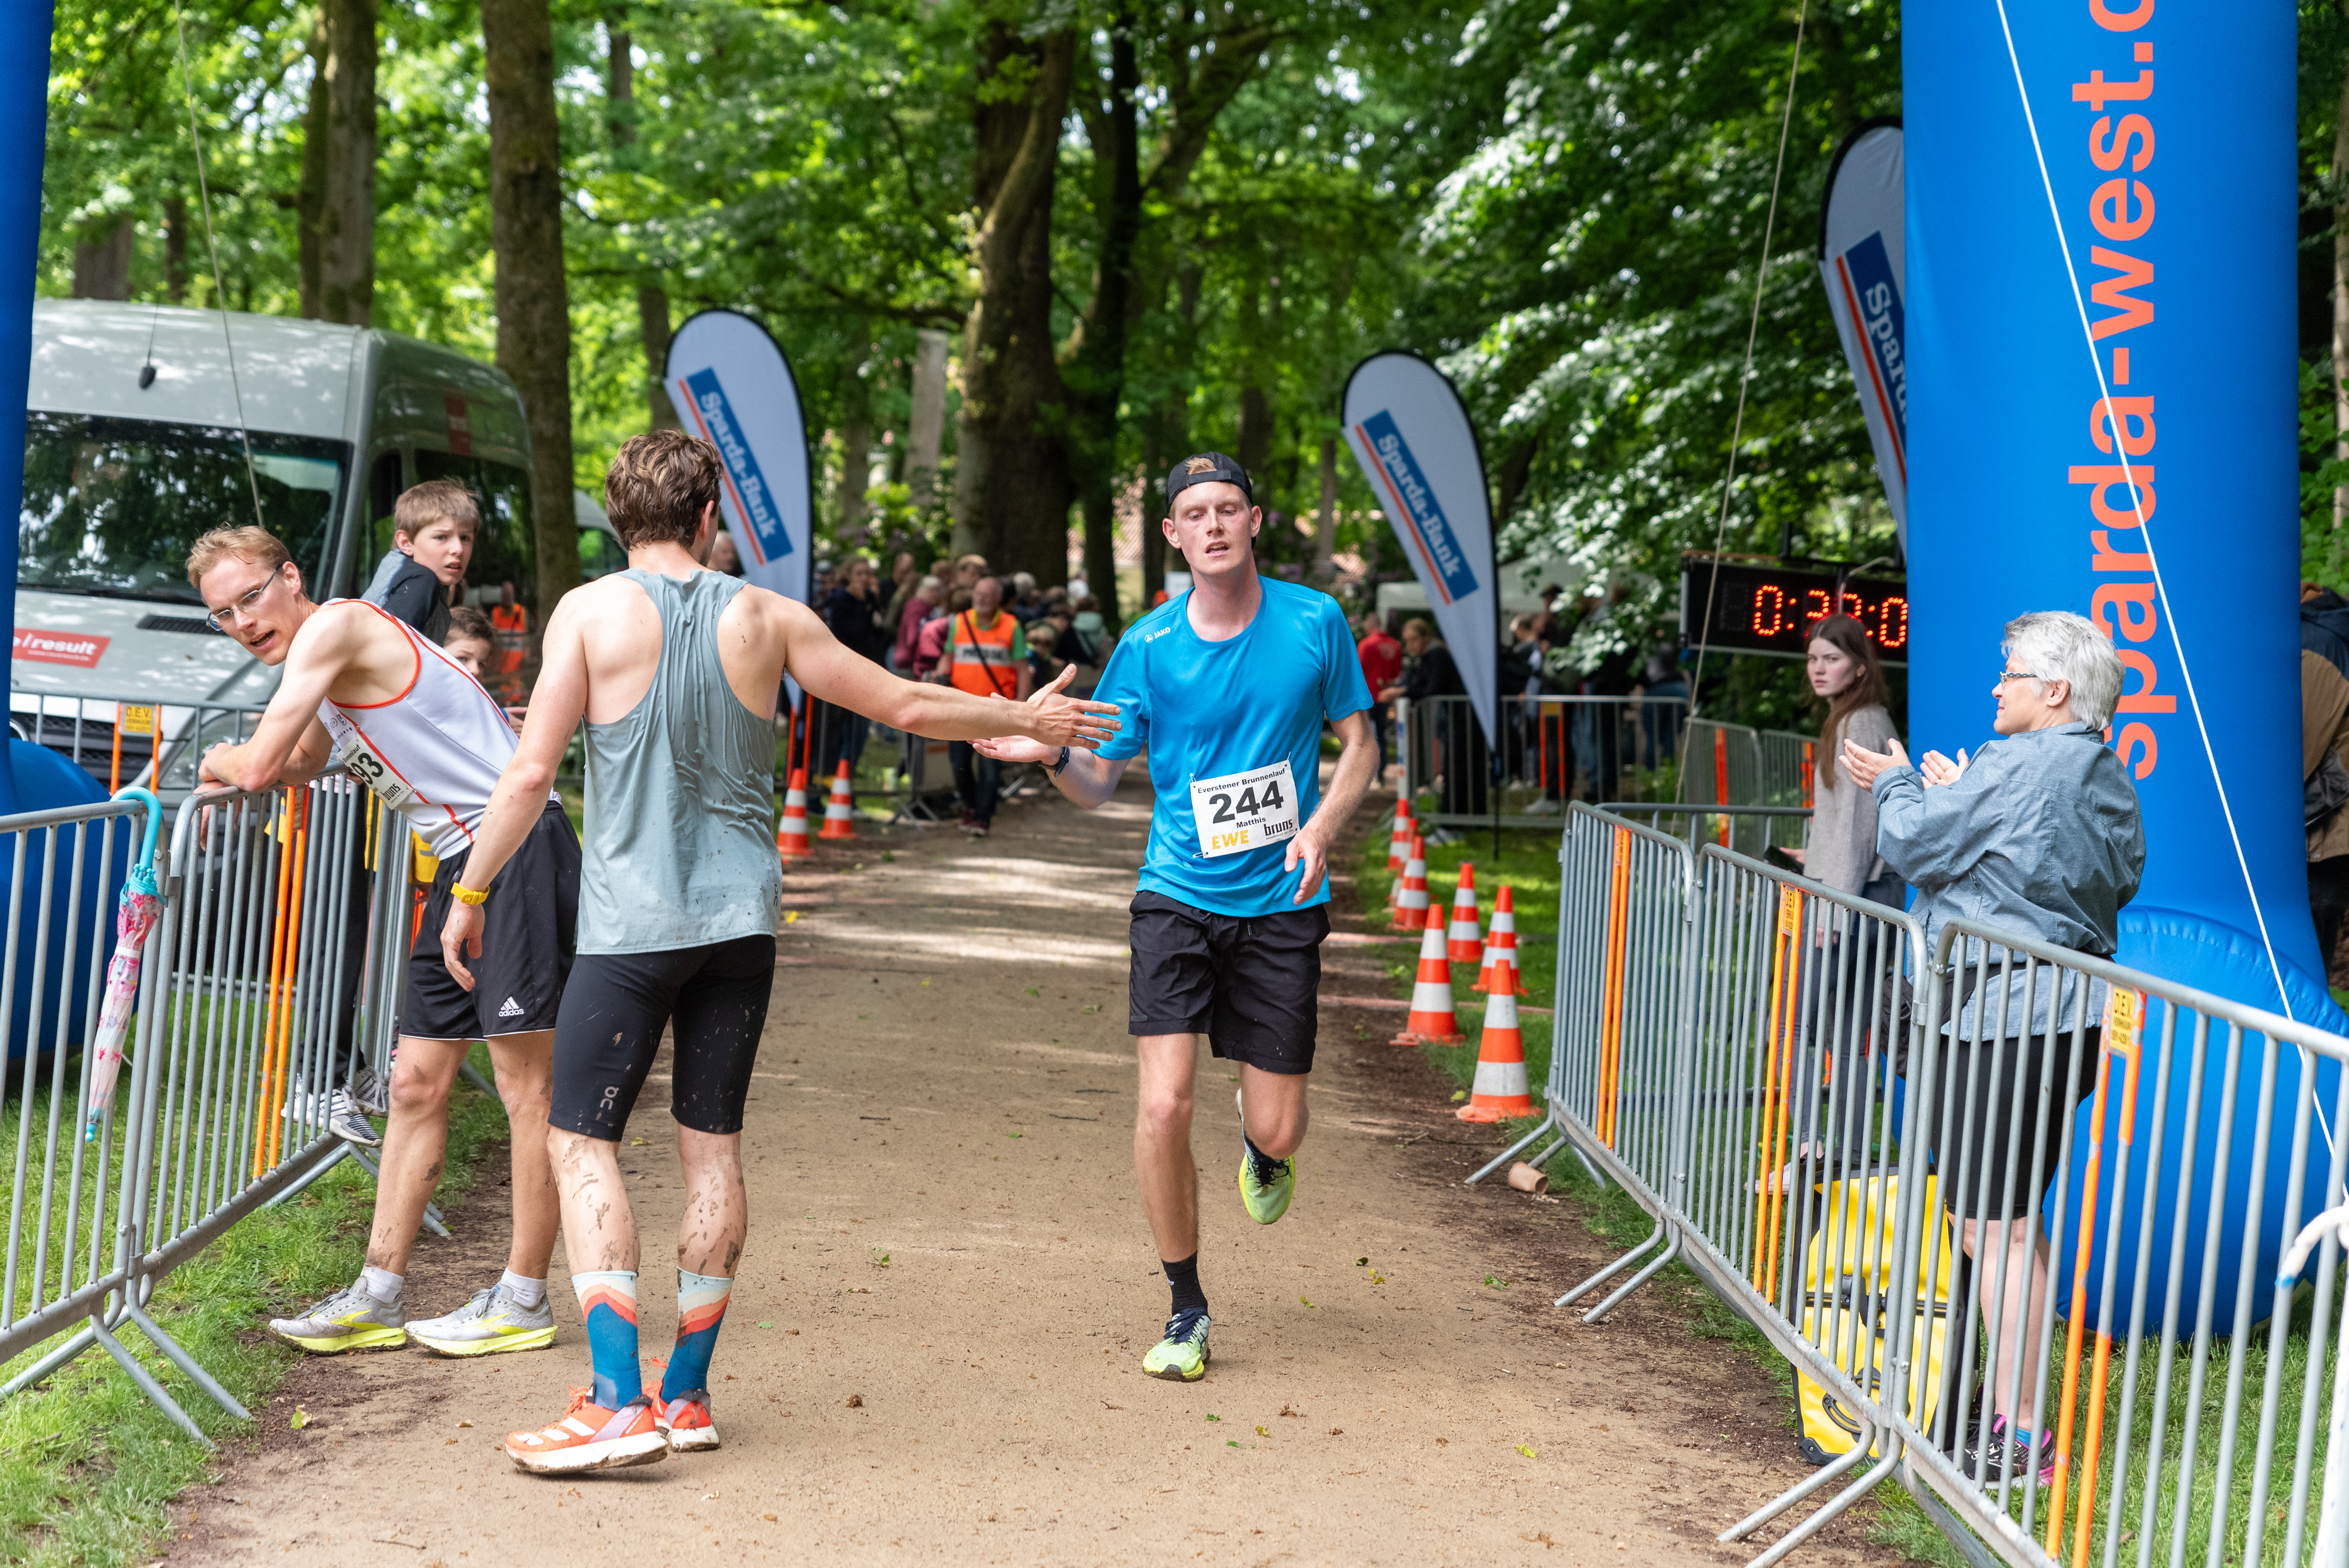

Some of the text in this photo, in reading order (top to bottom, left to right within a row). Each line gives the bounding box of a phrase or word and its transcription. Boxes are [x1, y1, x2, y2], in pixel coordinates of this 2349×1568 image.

[700, 391, 777, 539] Sparda-Bank
[1377, 433, 1460, 577] Sparda-Bank
[1154, 626, 1171, 639] JAKO
[347, 752, 384, 785] 93
[379, 782, 401, 801] bruns
[1197, 768, 1286, 794] Everstener Brunnenlauf
[1209, 780, 1284, 824] 244
[1236, 817, 1266, 829] Matthis
[1263, 818, 1293, 836] bruns
[1212, 829, 1249, 850] EWE
[499, 1008, 525, 1017] adidas
